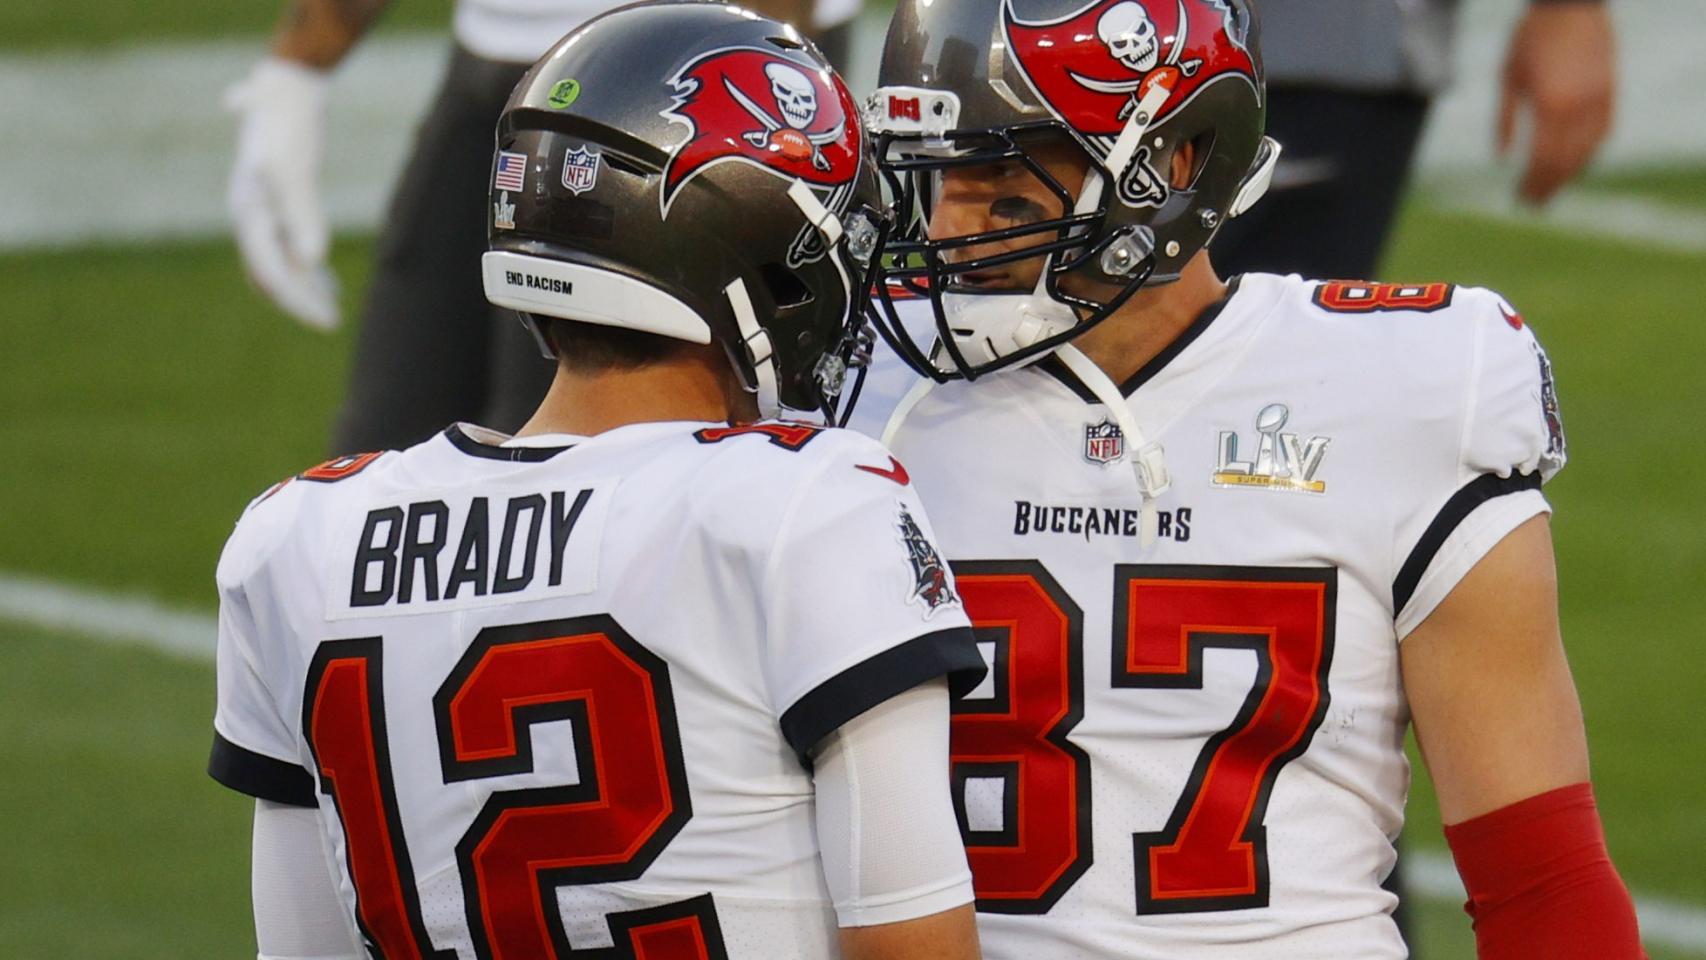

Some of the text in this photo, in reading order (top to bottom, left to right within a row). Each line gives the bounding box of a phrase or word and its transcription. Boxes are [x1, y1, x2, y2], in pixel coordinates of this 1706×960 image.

[505, 270, 573, 295] END RACISM
[350, 489, 594, 607] BRADY
[1014, 500, 1192, 543] BUCCANERS
[302, 613, 730, 960] 12
[949, 559, 1338, 916] 87
